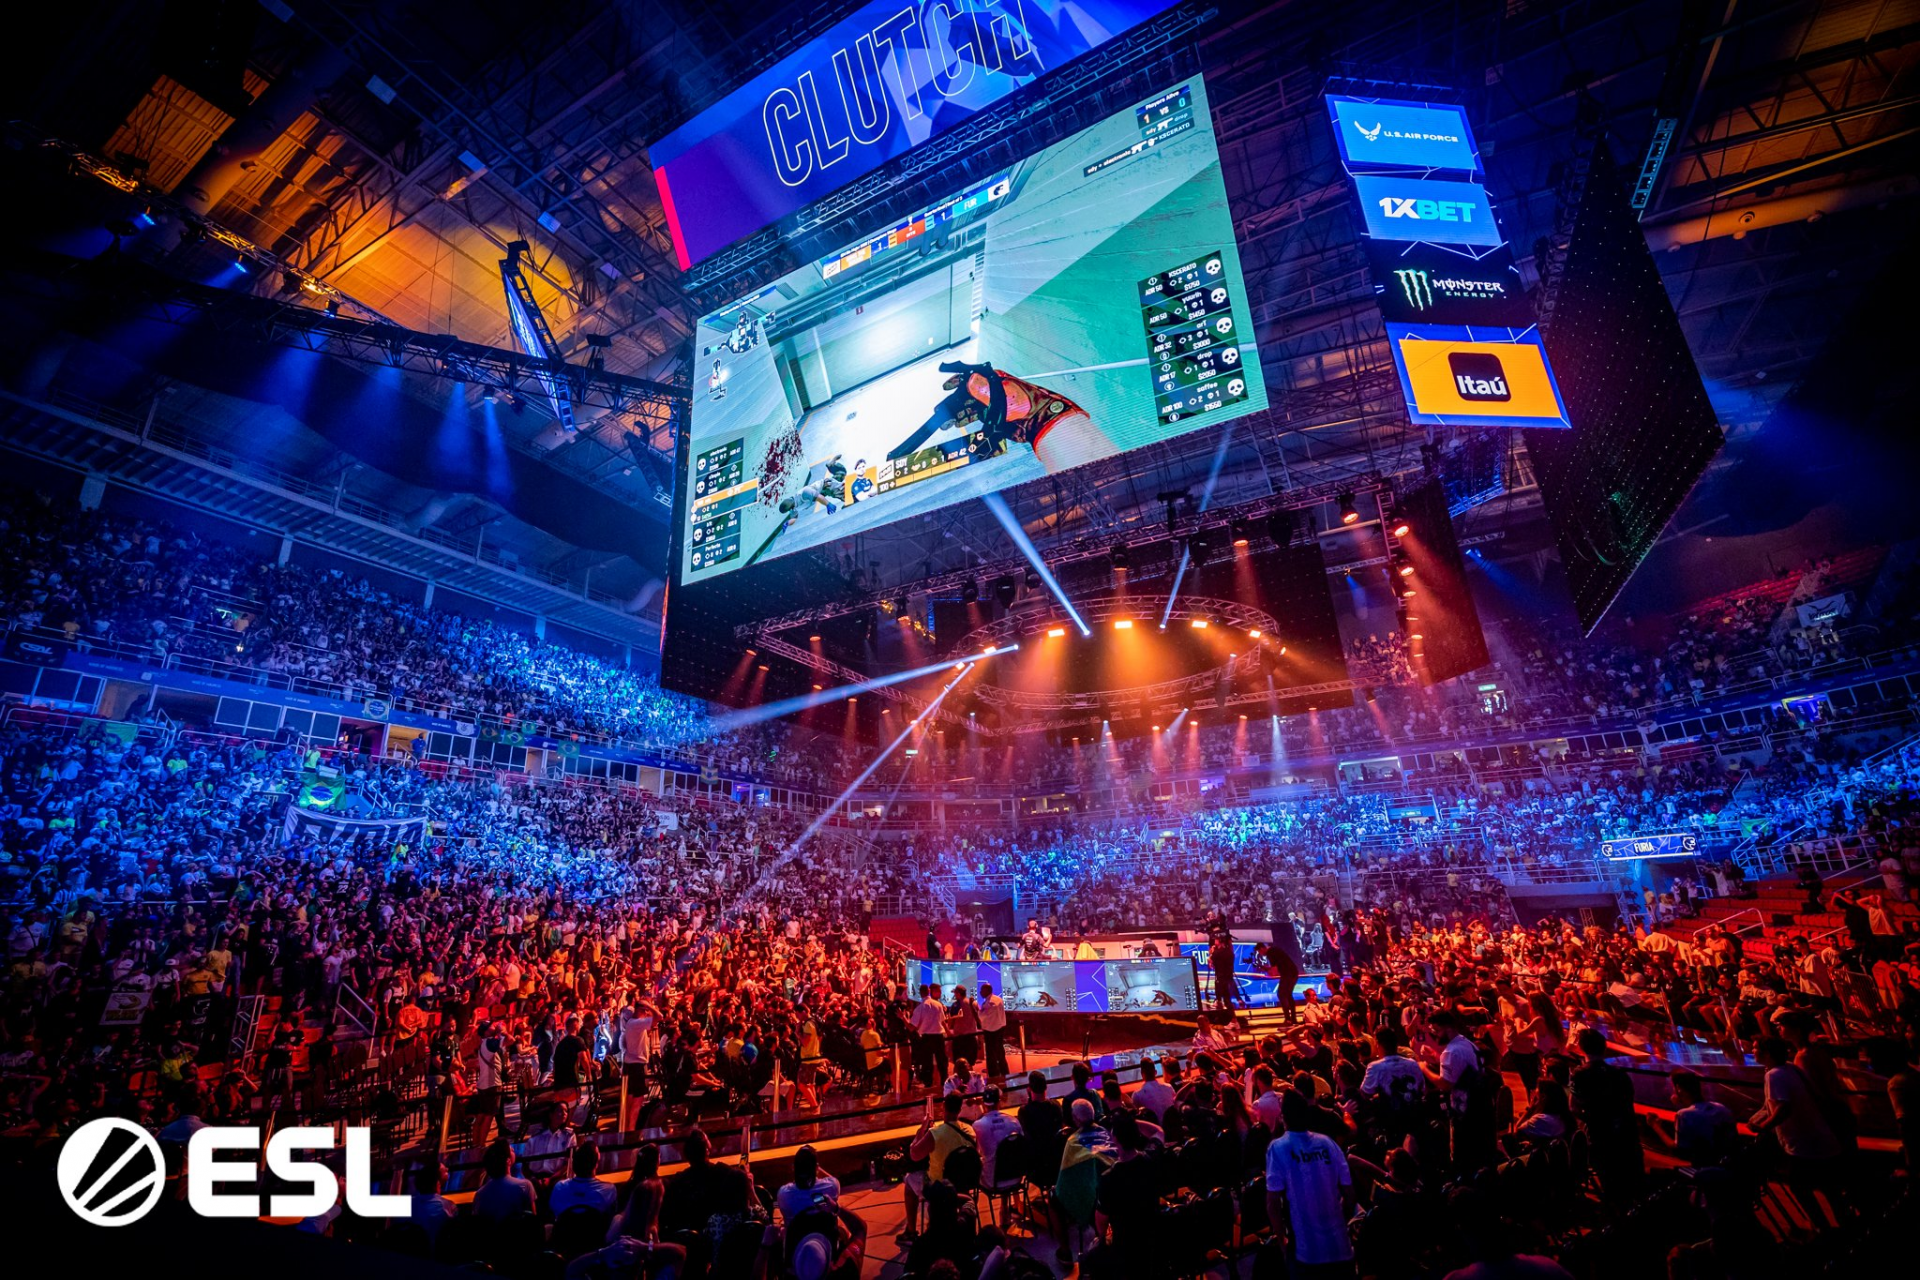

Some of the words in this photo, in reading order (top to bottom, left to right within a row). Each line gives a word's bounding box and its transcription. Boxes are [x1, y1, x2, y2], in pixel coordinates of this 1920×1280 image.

[763, 0, 1031, 187] CLUTCH
[1146, 98, 1165, 110] Players
[1166, 91, 1179, 100] Alive
[1144, 114, 1149, 123] 1
[1178, 98, 1185, 107] 0
[1174, 113, 1188, 121] drop
[1159, 122, 1190, 140] KSCERATO
[1424, 134, 1458, 142] FORCE
[964, 198, 977, 210] FUR
[1379, 197, 1476, 222] 1XBET
[1432, 278, 1504, 292] MONSTER
[1197, 351, 1212, 361] drop
[1456, 376, 1507, 395] Itaú
[879, 482, 888, 492] 100
[1634, 842, 1655, 853] FURIA
[1300, 1147, 1331, 1164] bmg
